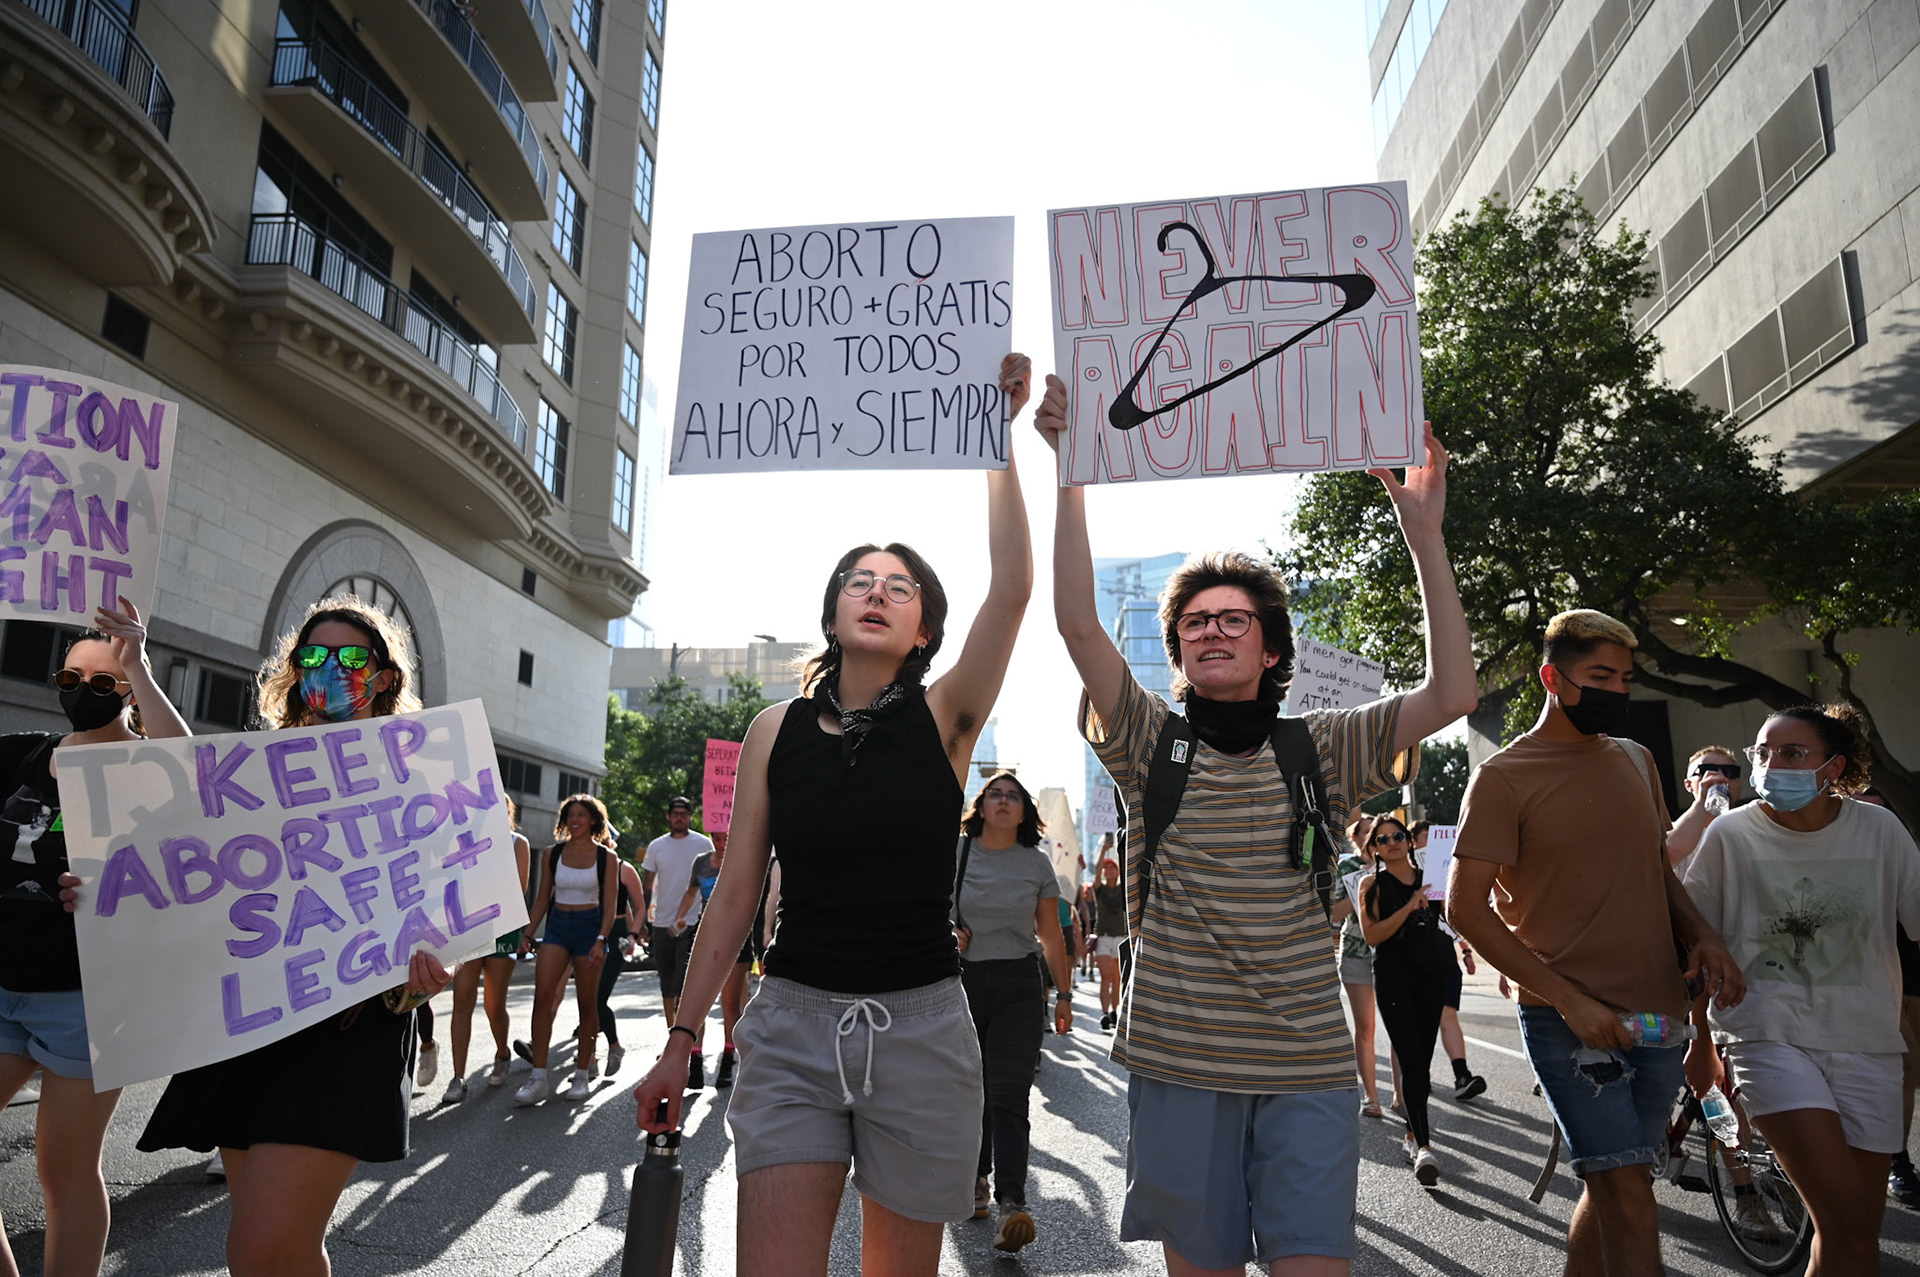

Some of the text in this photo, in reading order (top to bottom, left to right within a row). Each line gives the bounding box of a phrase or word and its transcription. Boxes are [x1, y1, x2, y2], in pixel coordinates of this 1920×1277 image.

[731, 224, 942, 285] ABORTO
[1054, 186, 1415, 331] NEVER
[700, 286, 853, 334] SEGURO
[886, 280, 1012, 327] GRATIS
[738, 332, 960, 387] POR TODOS
[1066, 311, 1417, 486] AGAIN
[0, 372, 166, 470] TION
[679, 396, 821, 462] AHORA
[847, 383, 1009, 462] SIEMPRE
[1299, 659, 1312, 674] You
[1315, 669, 1337, 681] could
[1338, 676, 1350, 686] get
[1300, 640, 1310, 652] If
[1313, 646, 1335, 659] men
[1339, 656, 1354, 668] got
[1317, 685, 1343, 698] at an
[194, 718, 427, 818] KEEP
[95, 768, 499, 918] ABORTION
[225, 850, 425, 958] SAFE
[221, 879, 501, 1037] LEGAL
